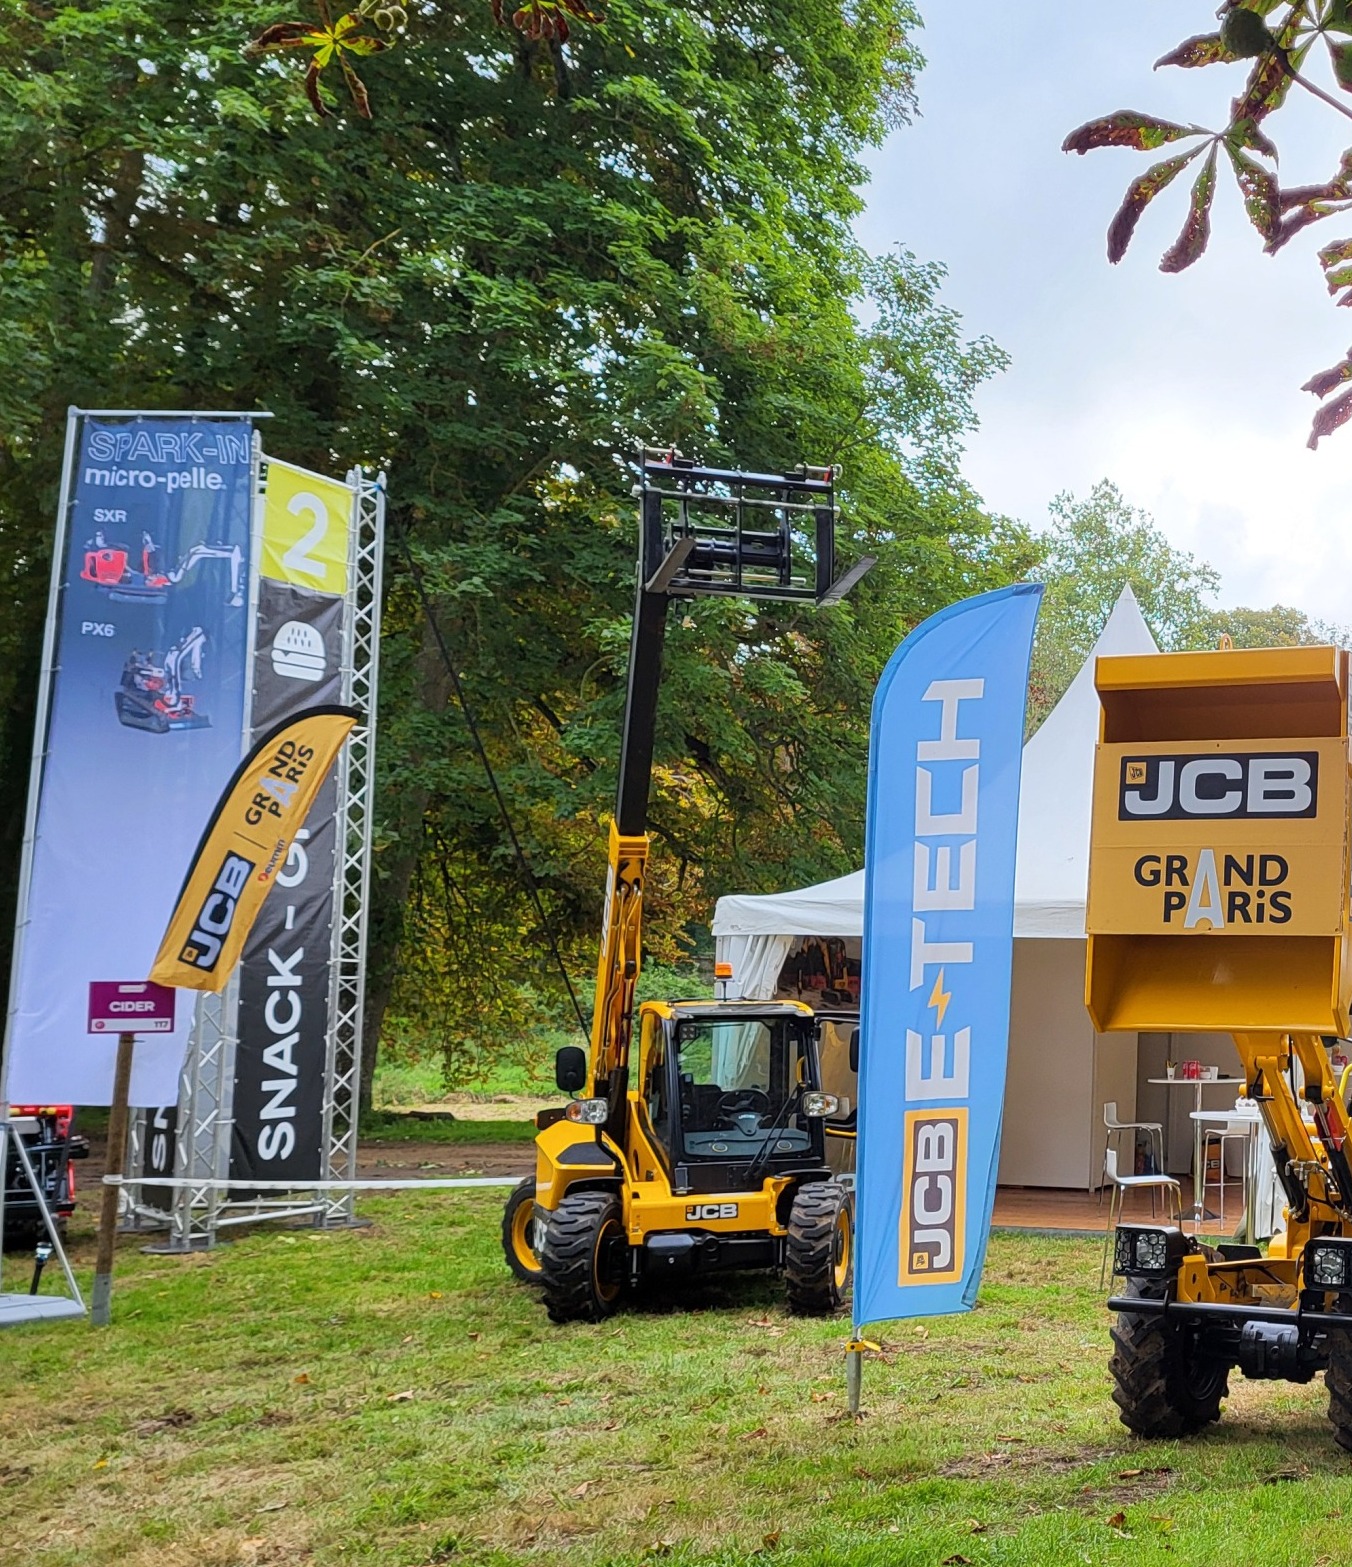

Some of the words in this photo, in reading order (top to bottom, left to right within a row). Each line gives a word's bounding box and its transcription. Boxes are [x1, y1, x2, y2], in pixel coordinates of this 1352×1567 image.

[88, 431, 250, 464] SPARK-IN
[93, 509, 127, 523] SXR
[282, 492, 328, 577] 2
[81, 622, 115, 637] PX6
[245, 740, 296, 826] GRAND
[1124, 758, 1312, 815] JCB
[1134, 849, 1289, 888] GRAND
[190, 855, 251, 968] JCB
[109, 1001, 156, 1012] CIDER
[257, 947, 304, 1160] SNACK
[686, 1204, 738, 1220] JCB
[913, 1122, 954, 1269] JCB
